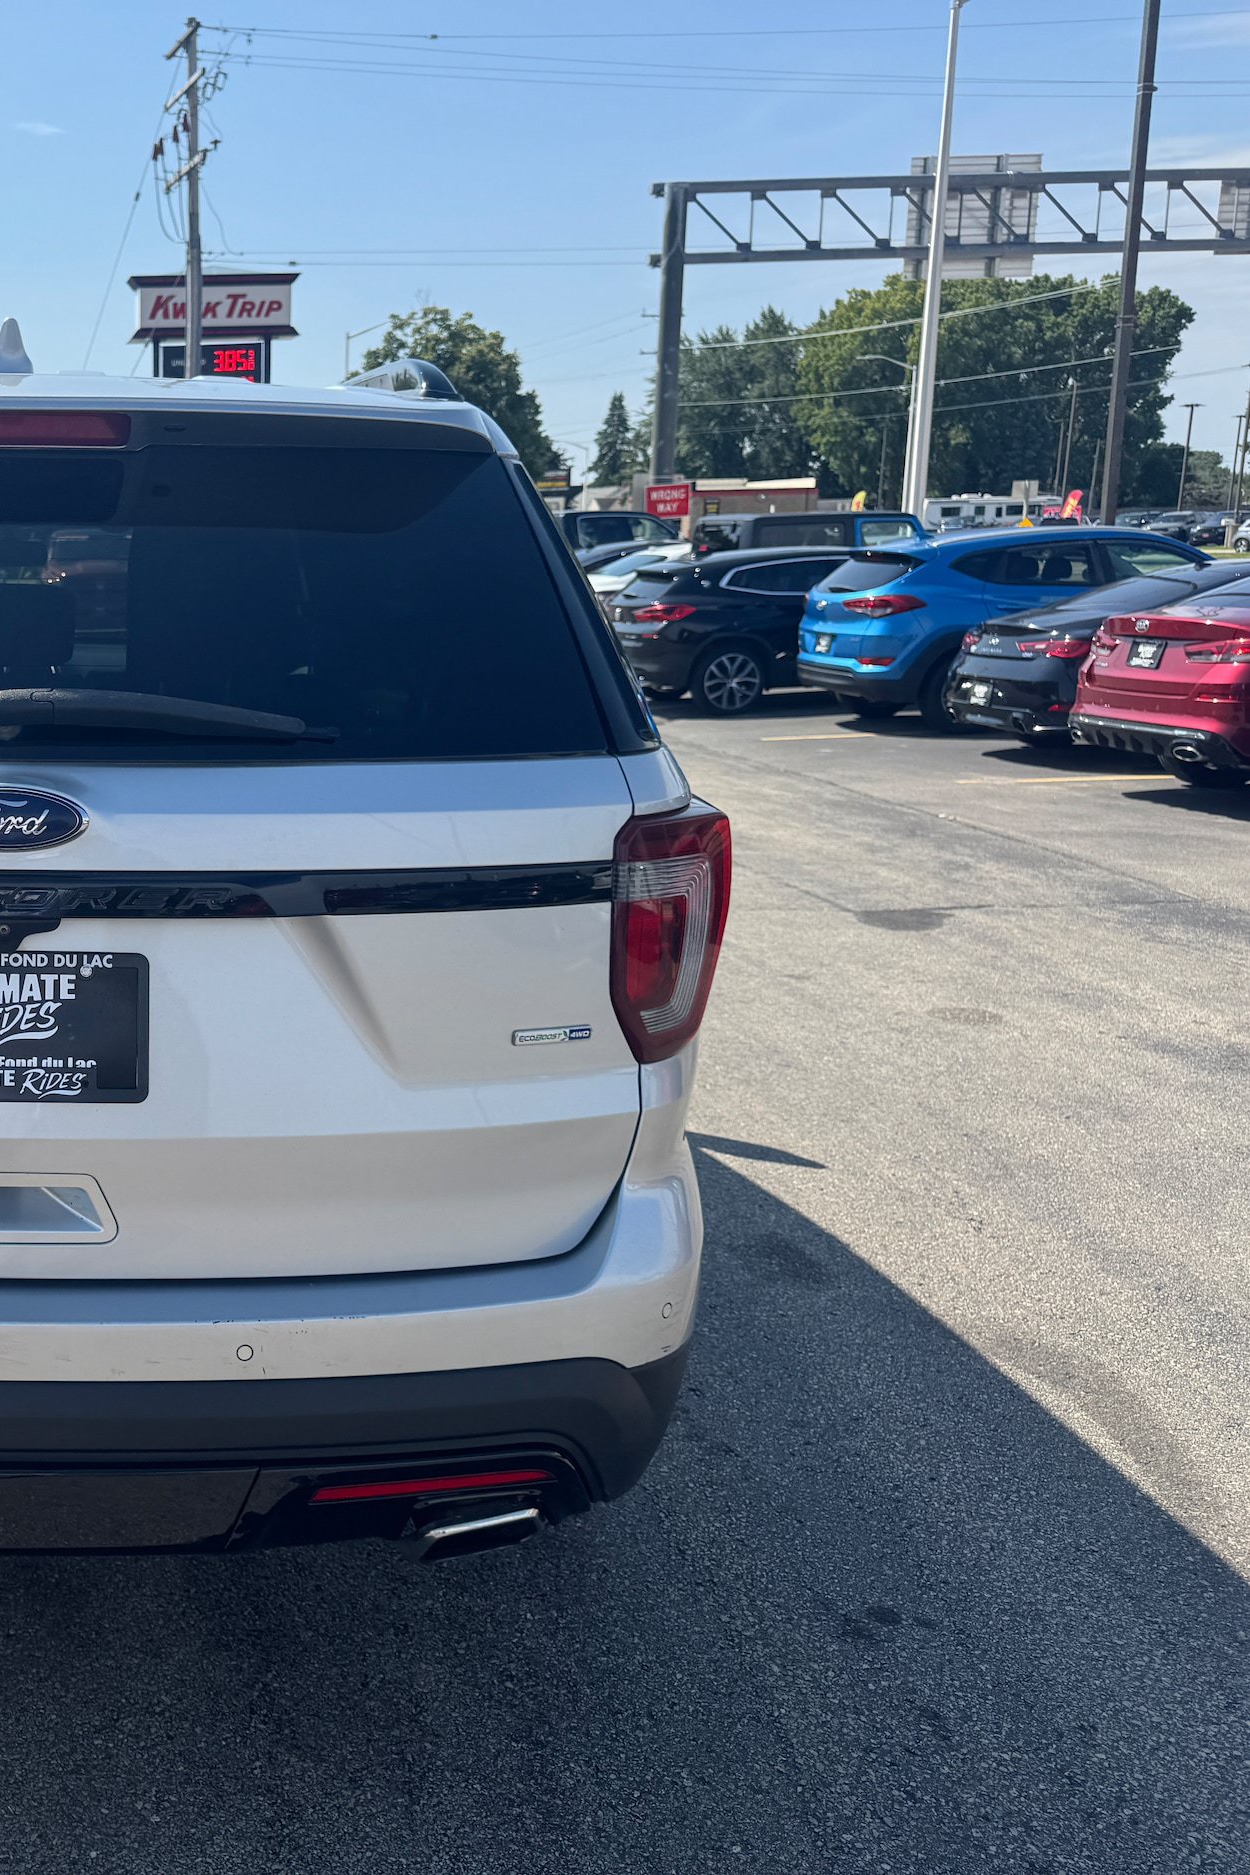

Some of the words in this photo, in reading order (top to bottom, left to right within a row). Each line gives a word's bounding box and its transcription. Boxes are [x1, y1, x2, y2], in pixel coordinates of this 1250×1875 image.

[149, 294, 223, 320] KWK
[225, 294, 283, 318] TRIP
[650, 489, 687, 500] WRONG
[656, 502, 678, 513] WAY
[0, 953, 48, 967] FOND
[53, 953, 78, 967] DU
[83, 953, 113, 968] LAC
[570, 1030, 590, 1038] 4WD
